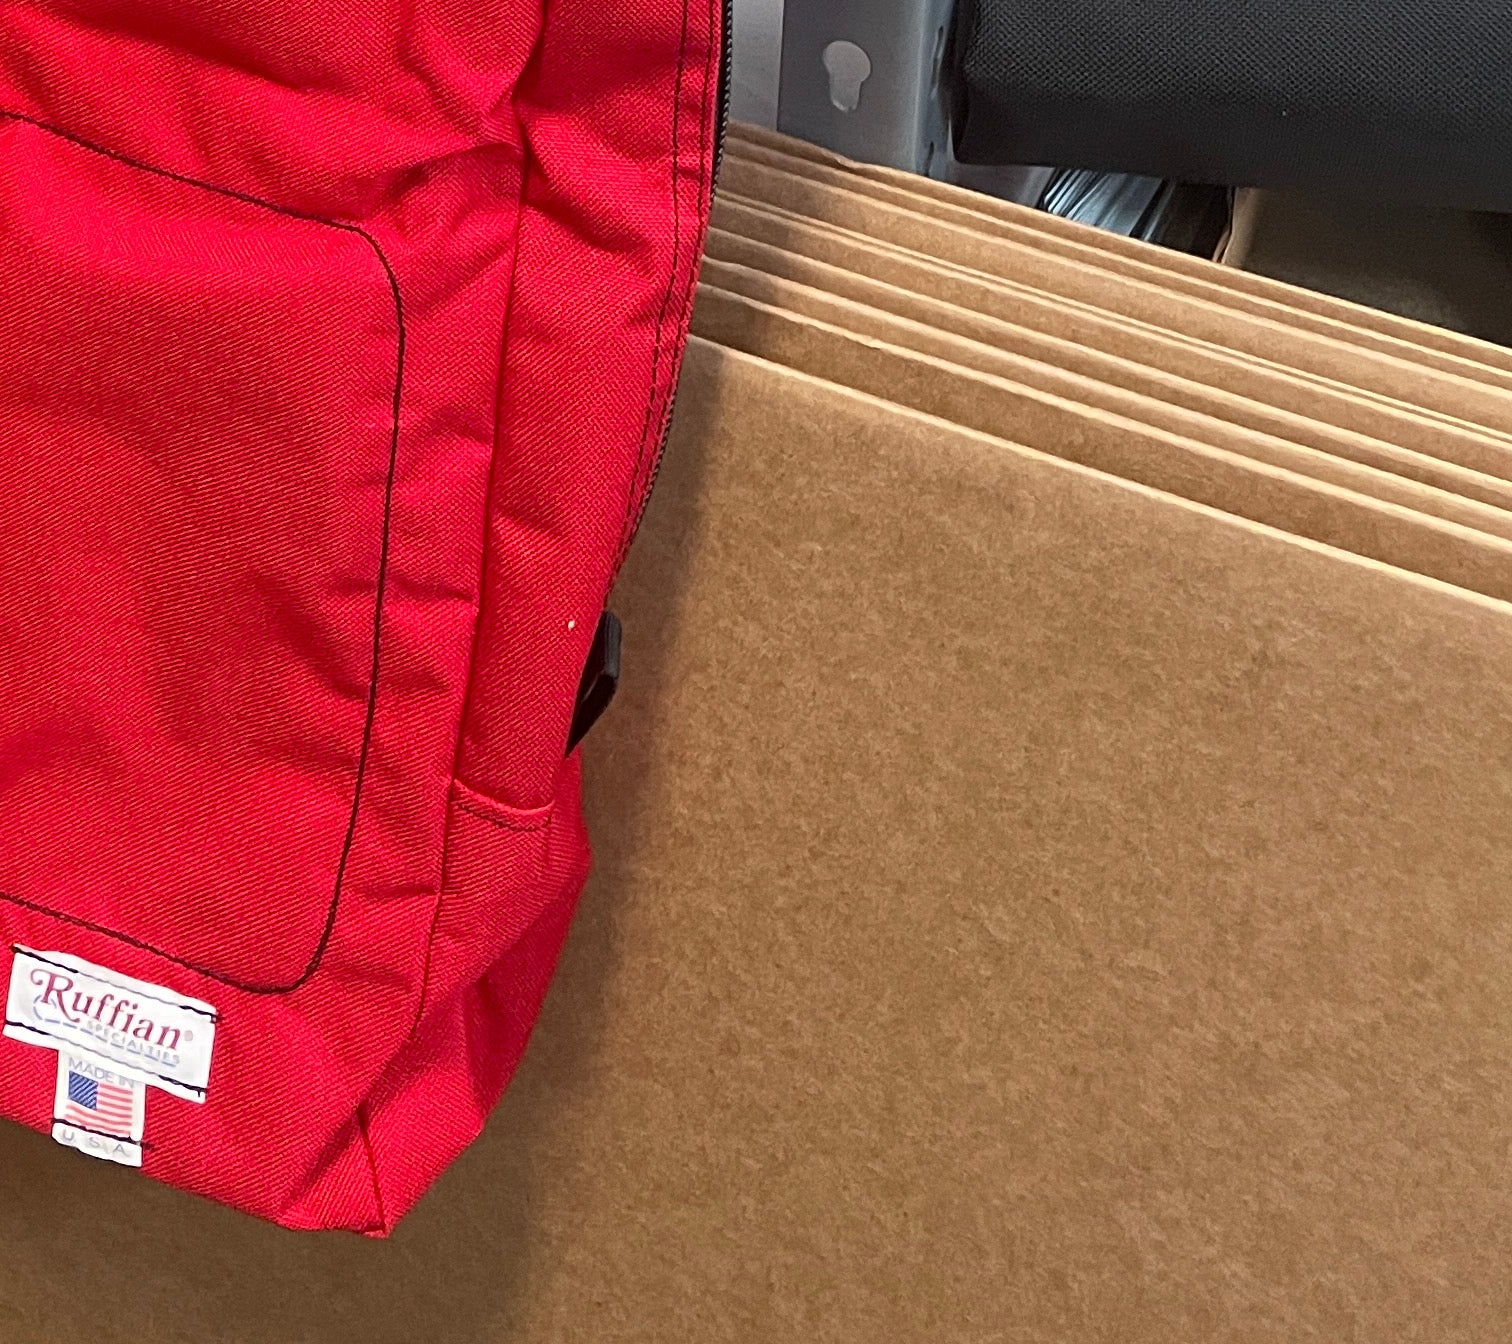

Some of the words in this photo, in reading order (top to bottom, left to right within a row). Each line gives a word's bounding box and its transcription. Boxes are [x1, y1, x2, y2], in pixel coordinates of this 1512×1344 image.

[30, 968, 182, 1050] Ruffian
[68, 1056, 115, 1084] MADE
[118, 1075, 135, 1089] IN
